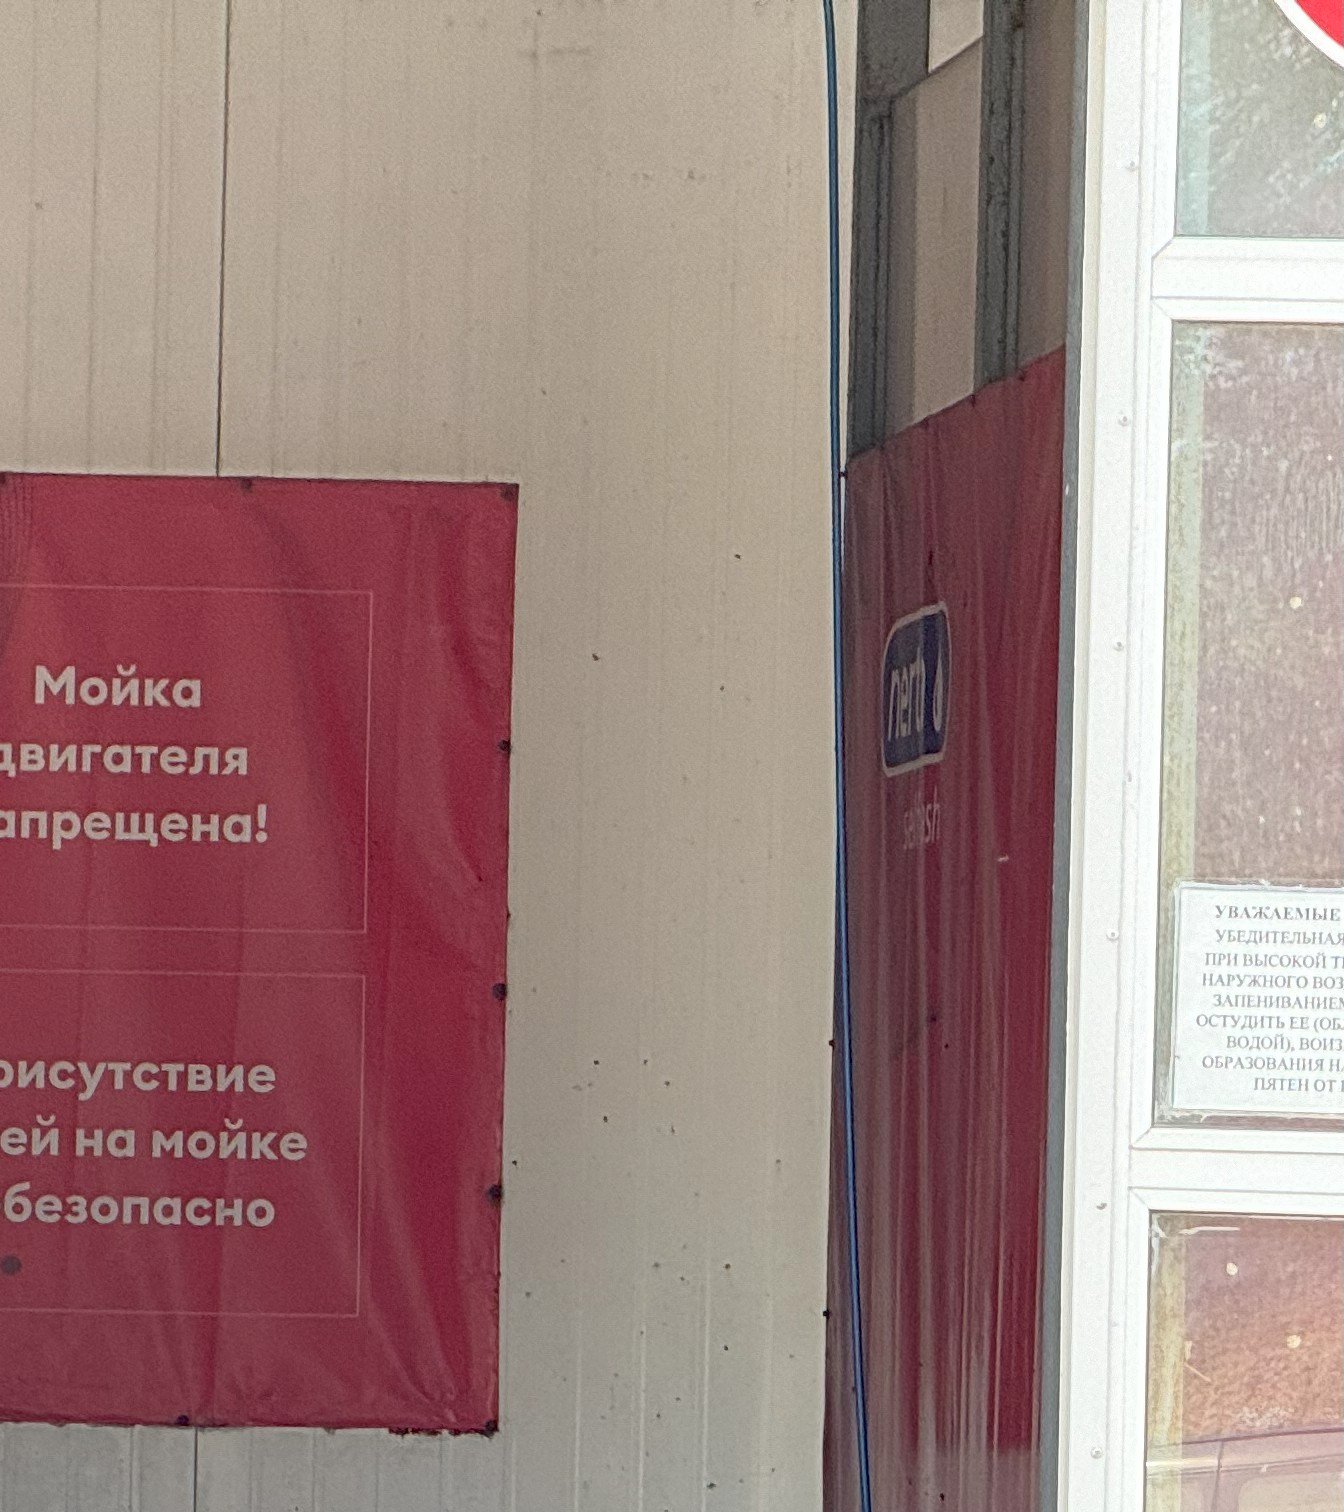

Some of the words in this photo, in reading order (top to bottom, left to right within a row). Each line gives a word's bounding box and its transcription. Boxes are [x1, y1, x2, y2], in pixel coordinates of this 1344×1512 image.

[34, 664, 201, 708] Мойка
[1215, 904, 1341, 922] УВАЖАЕМЫЕ
[1205, 952, 1238, 968] ПРИ
[1242, 952, 1327, 969] ВЫСОКОЙ
[1202, 973, 1309, 990] НАРУЖНОГО
[1195, 1014, 1286, 1030] ОСТУДИТЬ
[1289, 1016, 1310, 1031] ЕЕ
[1313, 1017, 1344, 1034] (ОБ
[1226, 1033, 1296, 1053] ВОДОЙ),
[1201, 1055, 1326, 1073] ОБРАЗОВАНИЯ
[1328, 1058, 1344, 1074] Н
[1253, 1077, 1309, 1093] ПЯТЕН
[1313, 1078, 1338, 1095] ОТ
[75, 1128, 136, 1158] на
[151, 1118, 308, 1161] мойке
